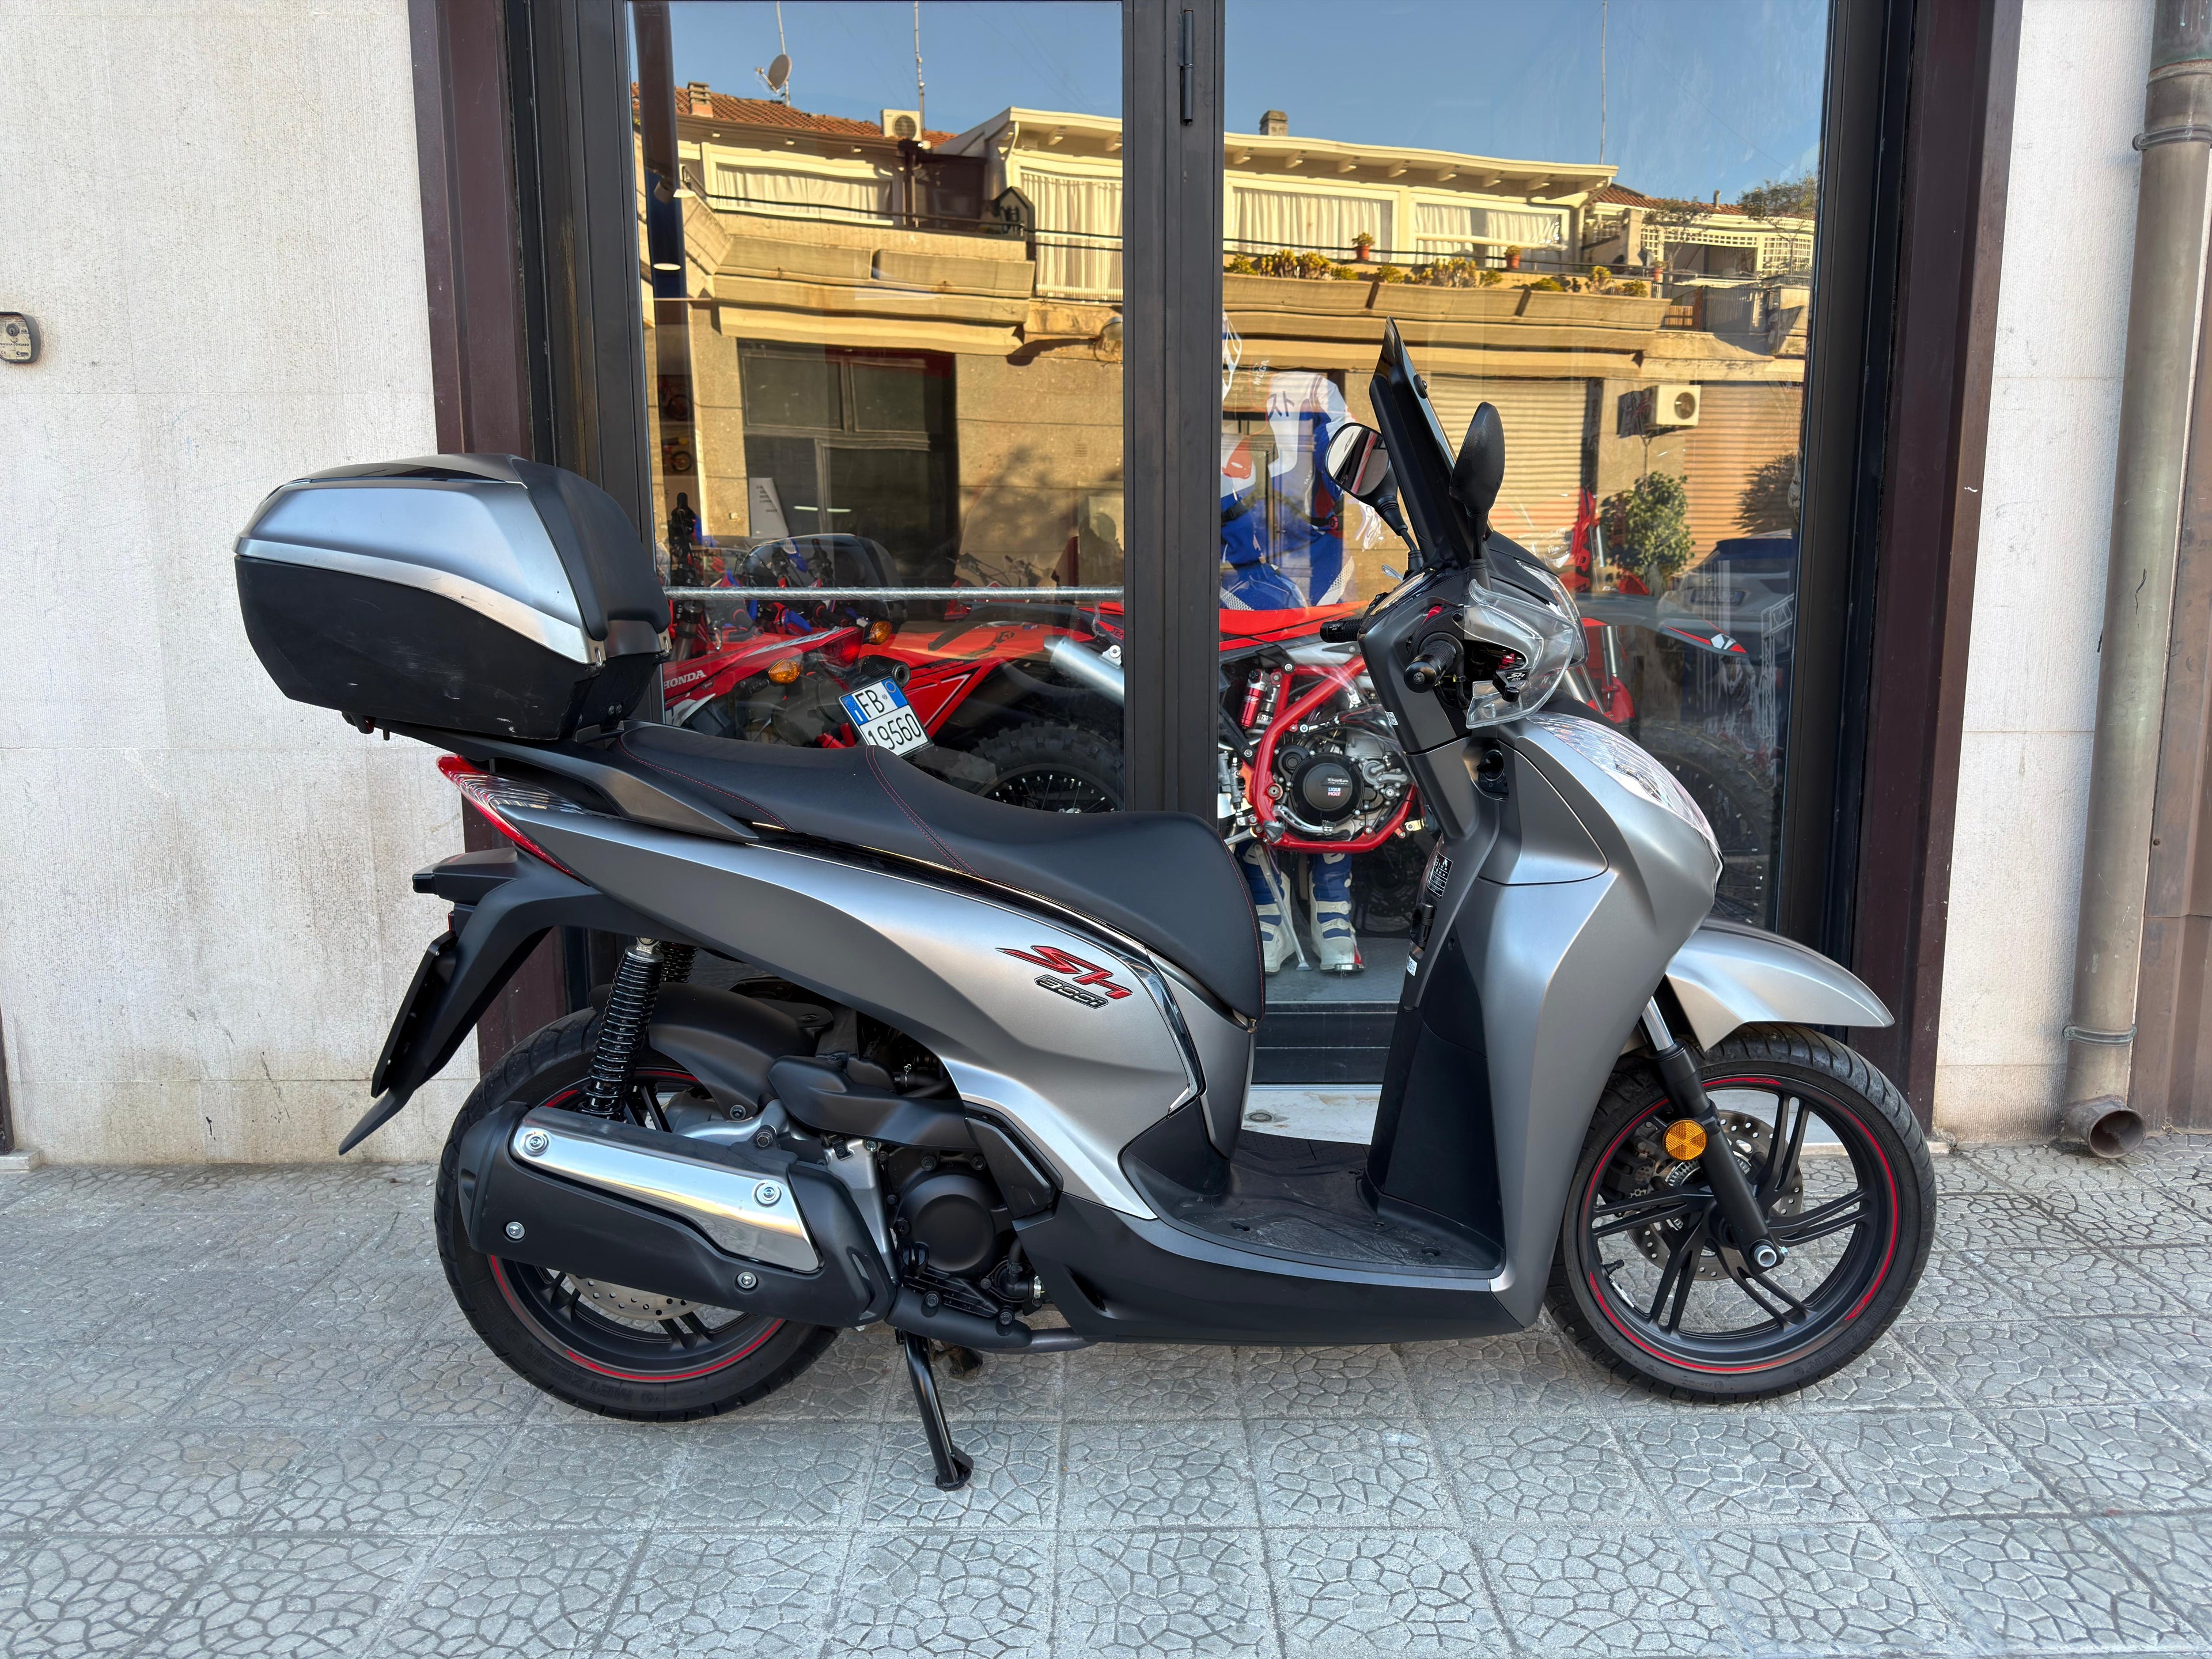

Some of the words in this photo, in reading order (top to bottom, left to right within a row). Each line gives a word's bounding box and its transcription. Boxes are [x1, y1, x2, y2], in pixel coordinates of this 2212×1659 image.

[664, 669, 707, 690] HONDA
[855, 690, 885, 718] FB
[867, 713, 921, 751] 19560
